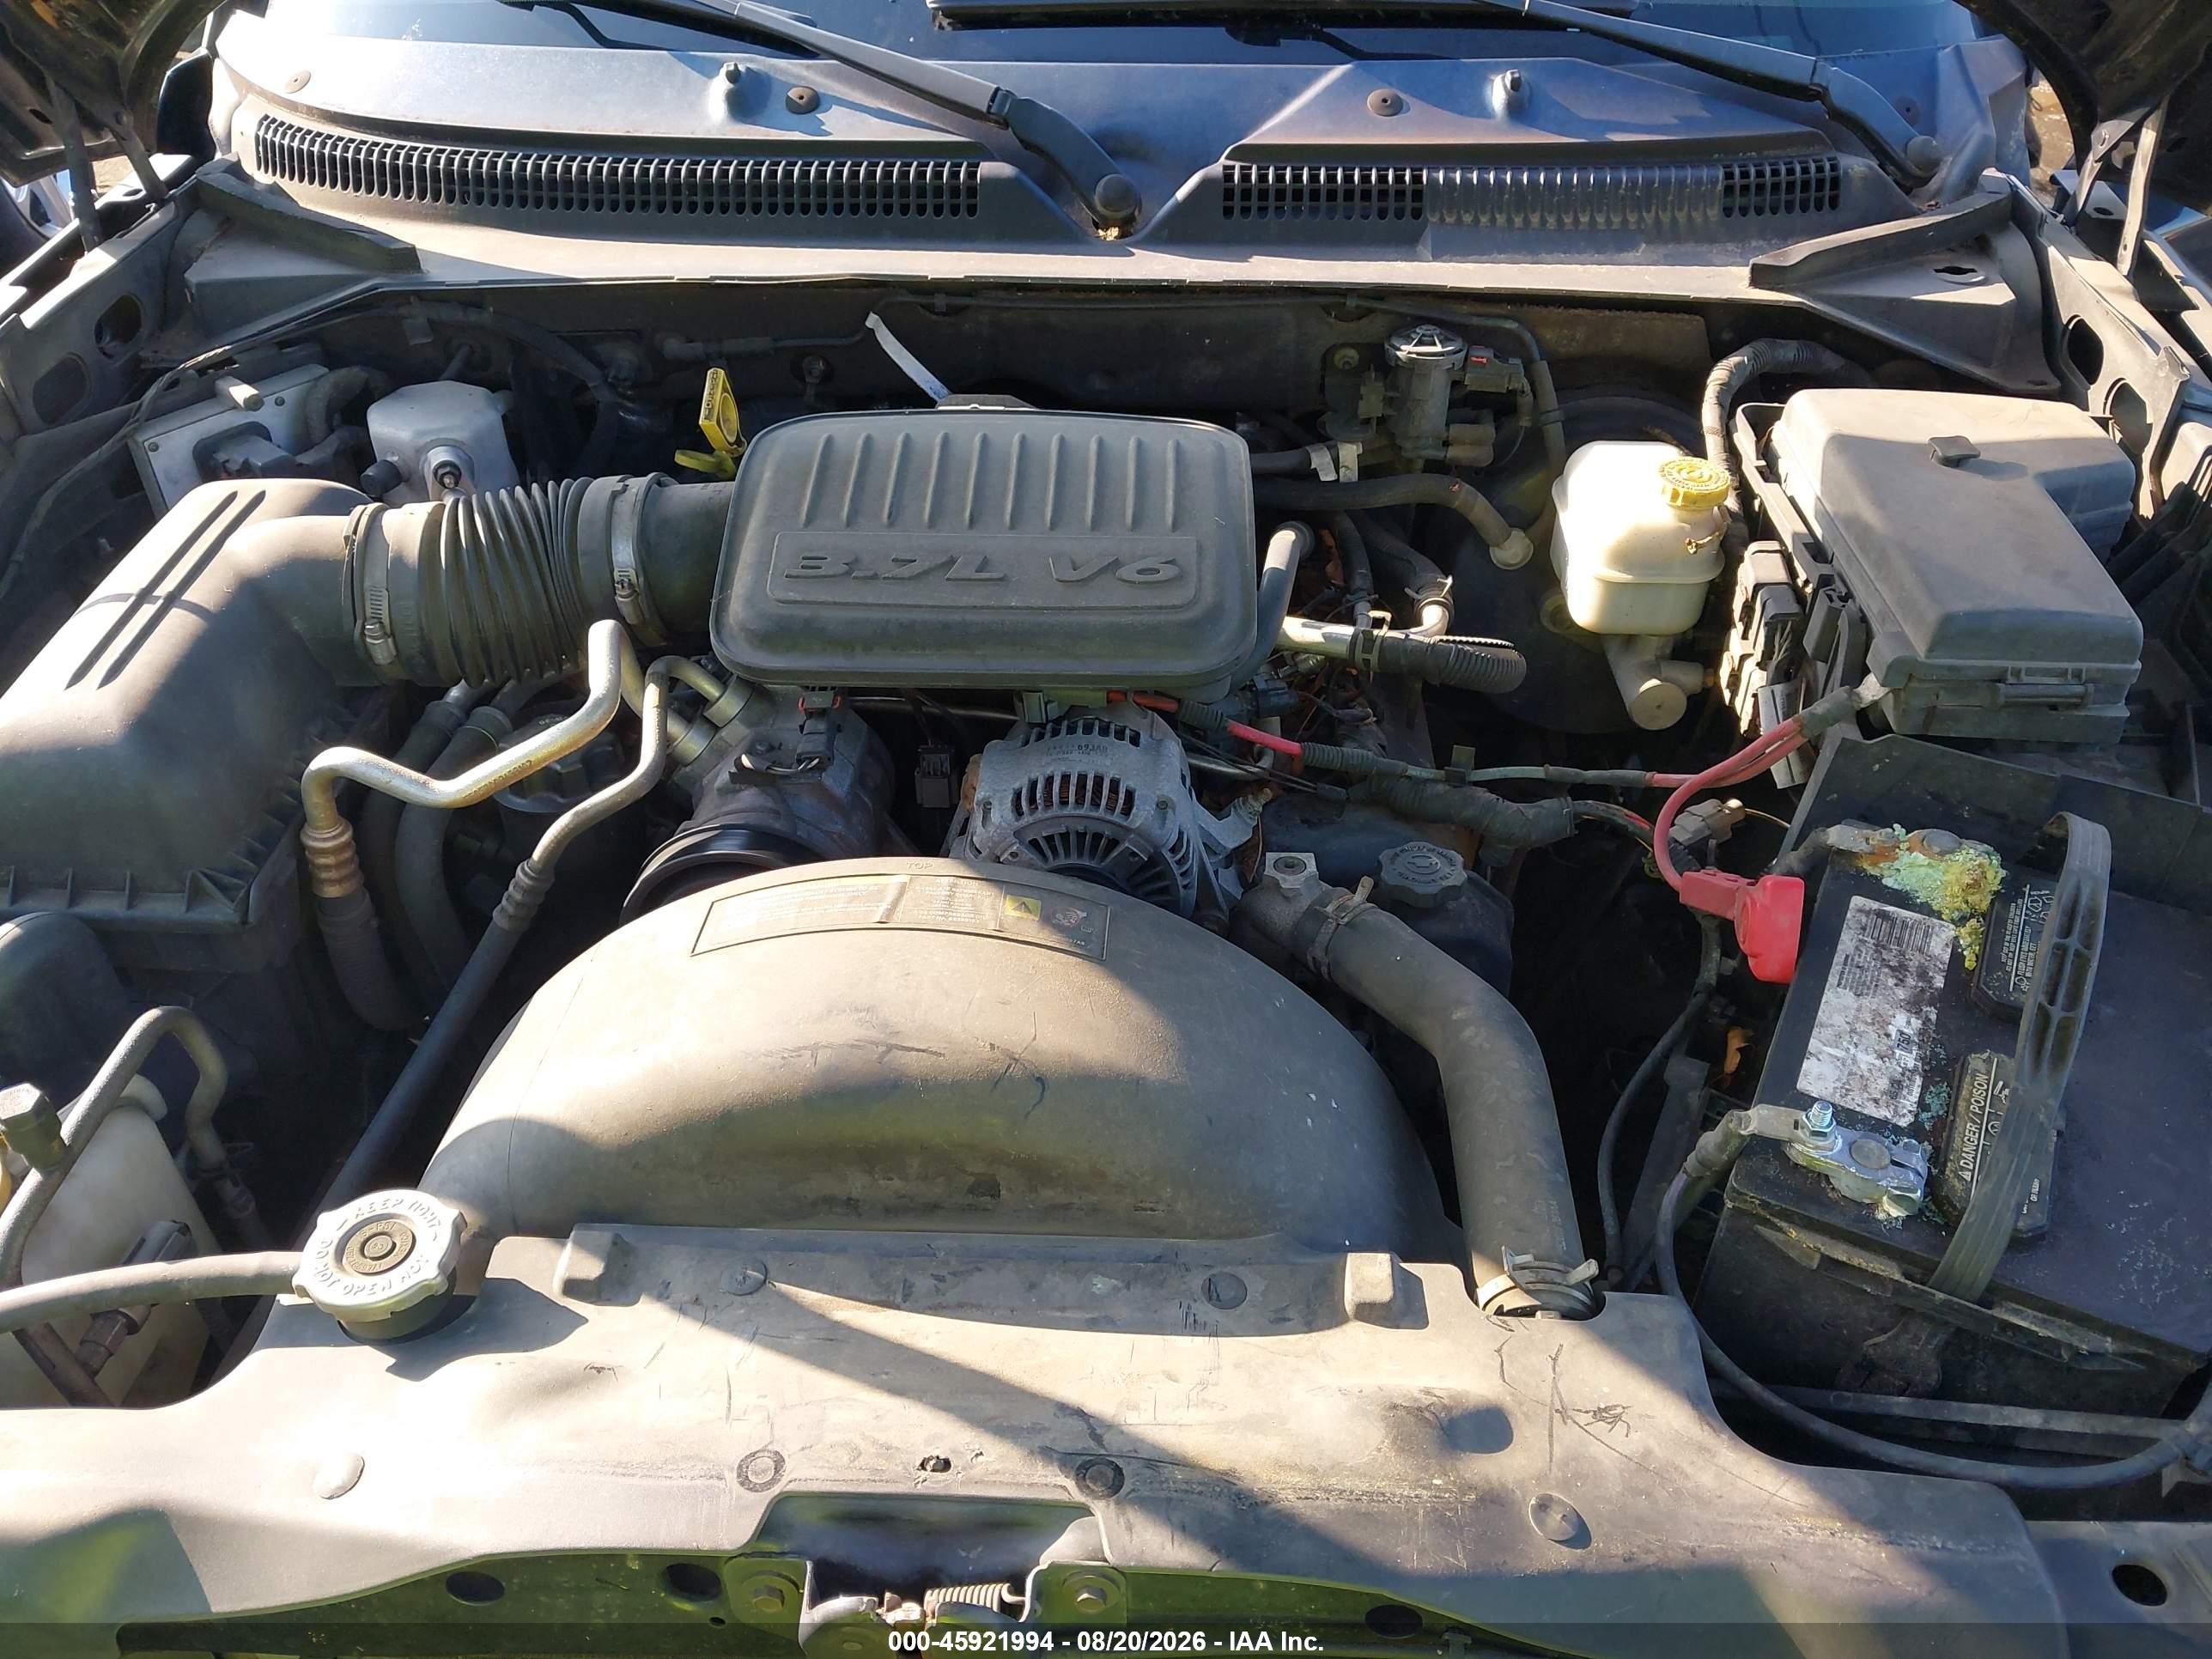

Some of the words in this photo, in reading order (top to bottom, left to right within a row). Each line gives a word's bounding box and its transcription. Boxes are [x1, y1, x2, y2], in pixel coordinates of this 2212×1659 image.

[782, 550, 1006, 583] 3.7L
[1047, 556, 1184, 585] V6
[906, 861, 933, 870] TOP
[1896, 1032, 1911, 1053] 750
[1960, 1122, 1979, 1170] DANGER
[1970, 1073, 1990, 1115] POISON
[355, 1198, 404, 1219] KEEP
[343, 1282, 393, 1297] OPEN
